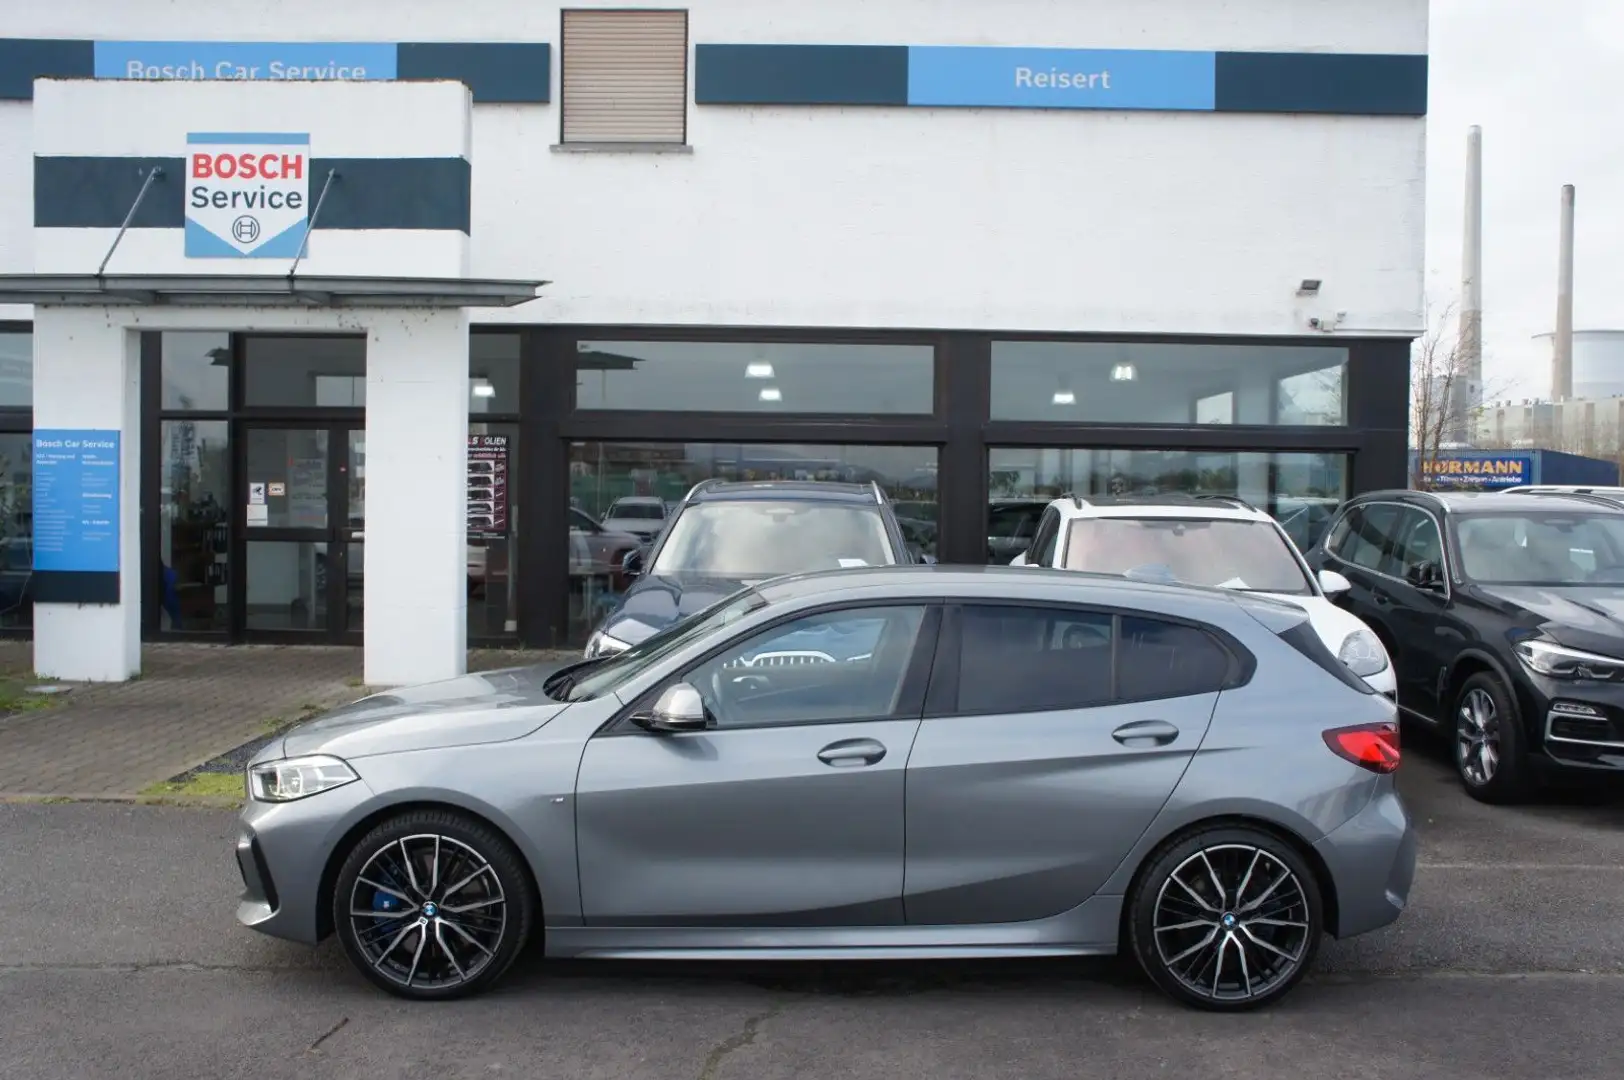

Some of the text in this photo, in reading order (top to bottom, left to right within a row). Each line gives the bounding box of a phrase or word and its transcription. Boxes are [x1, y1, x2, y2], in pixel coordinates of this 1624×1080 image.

[127, 60, 366, 80] Bosch Car Service
[1015, 66, 1111, 89] Reisert
[192, 153, 303, 179] BOSCH
[191, 184, 303, 209] Service
[36, 439, 115, 449] Bosch Car Service
